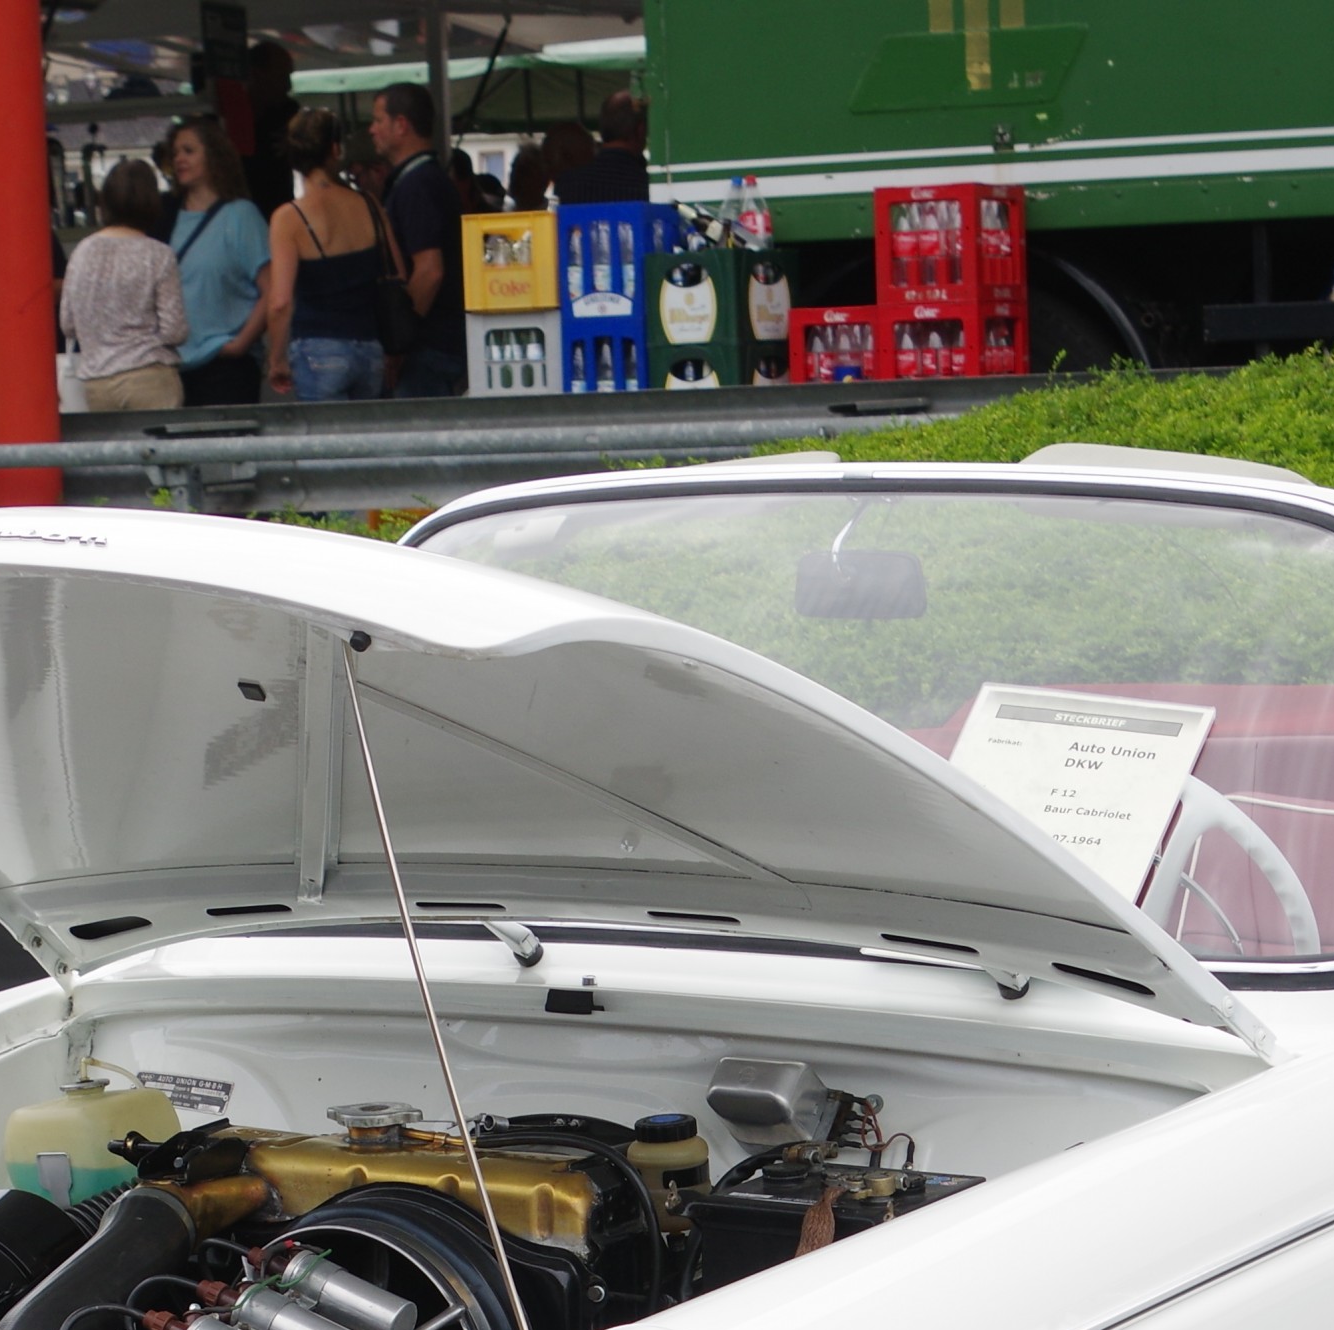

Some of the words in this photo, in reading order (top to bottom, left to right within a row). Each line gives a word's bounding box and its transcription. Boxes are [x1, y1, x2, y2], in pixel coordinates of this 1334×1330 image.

[1054, 712, 1127, 728] STECKBRIEF
[1068, 742, 1106, 754] Auto
[1111, 746, 1157, 760] Union
[1064, 758, 1104, 770] DKW
[1050, 788, 1058, 796] F
[1061, 789, 1077, 798] 12
[1044, 804, 1072, 814] Baur
[1075, 807, 1132, 821] Cabriolet
[157, 1075, 174, 1083] AUTO
